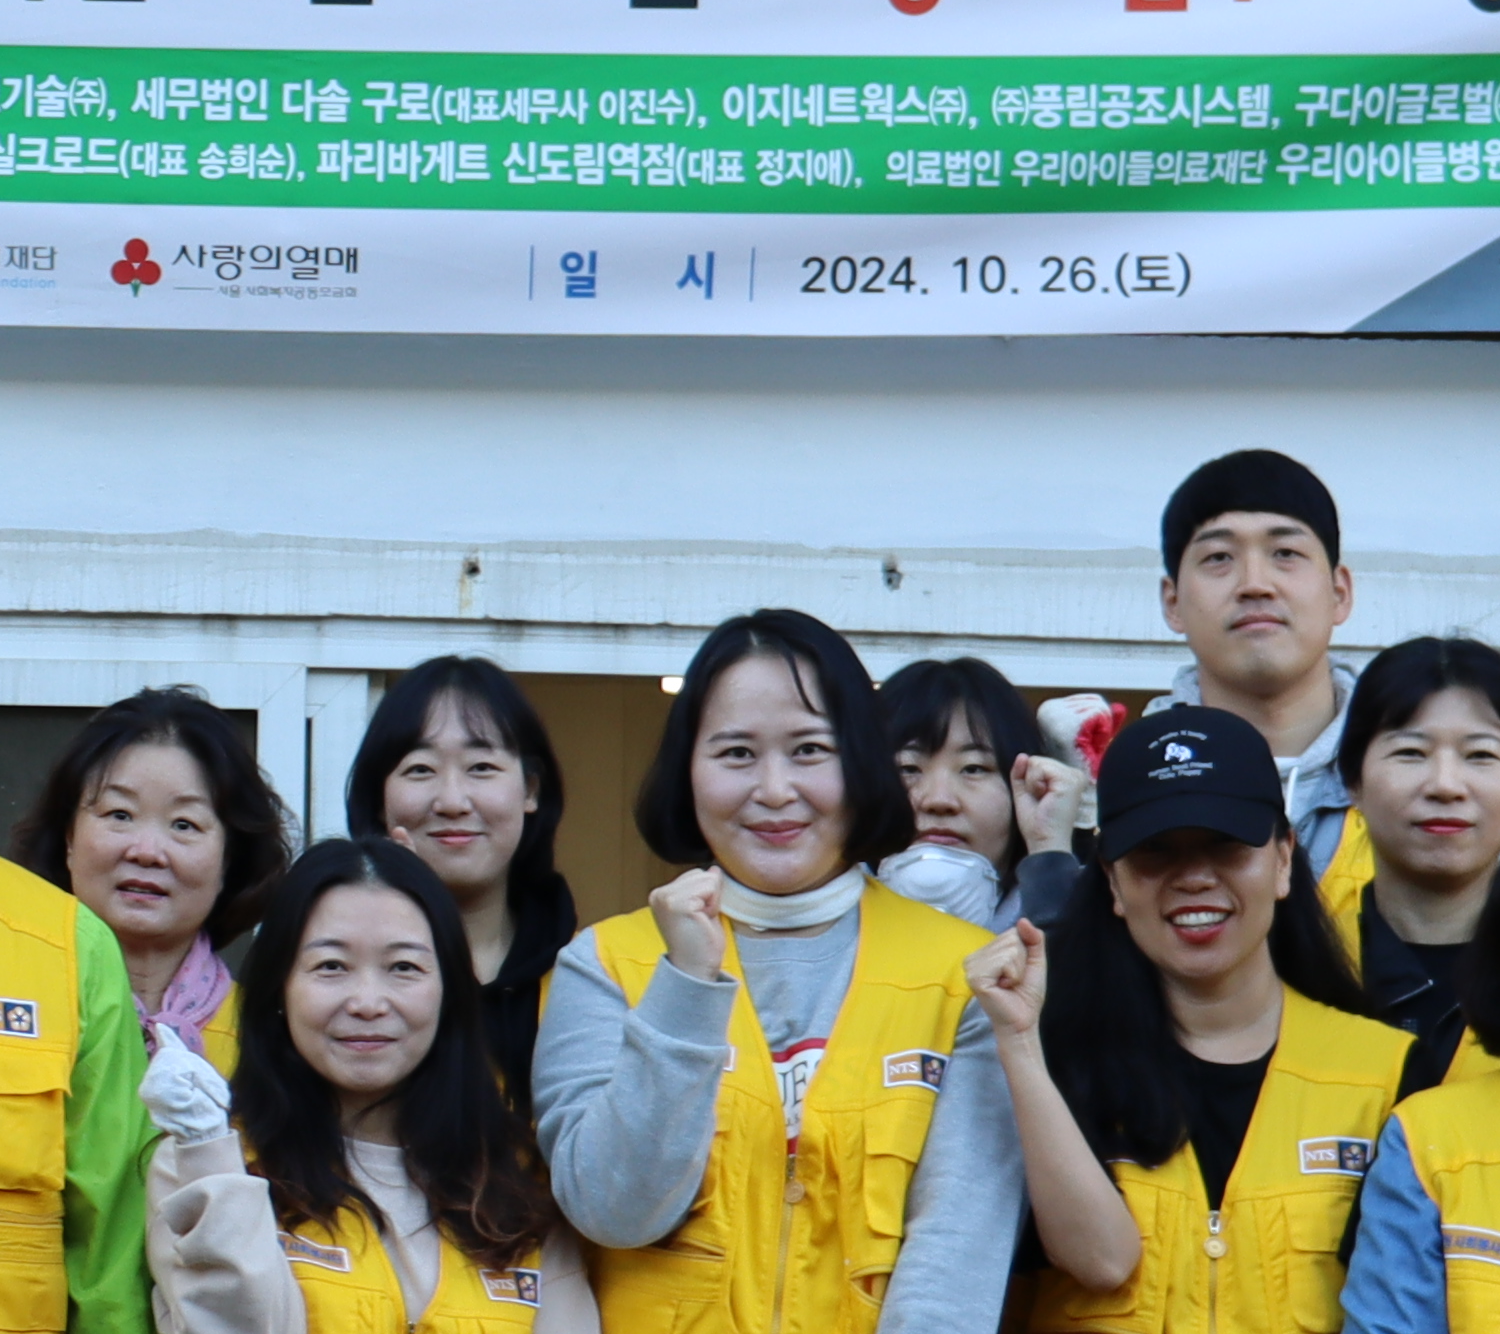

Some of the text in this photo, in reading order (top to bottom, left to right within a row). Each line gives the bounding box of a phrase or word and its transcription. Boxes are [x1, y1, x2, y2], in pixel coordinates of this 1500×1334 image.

[131, 75, 267, 122] 세무법인
[282, 80, 350, 123] 다솔
[316, 140, 490, 183] 파리바게트
[886, 151, 1000, 188] 의료법인
[1011, 149, 1268, 188] 우리아이들의료재단
[171, 244, 359, 281] 사랑의열매
[559, 250, 716, 299] 일 시
[801, 251, 1193, 298] 2024. 10. 26.(토)
[889, 1061, 919, 1075] NTS
[1304, 1148, 1335, 1163] NTS
